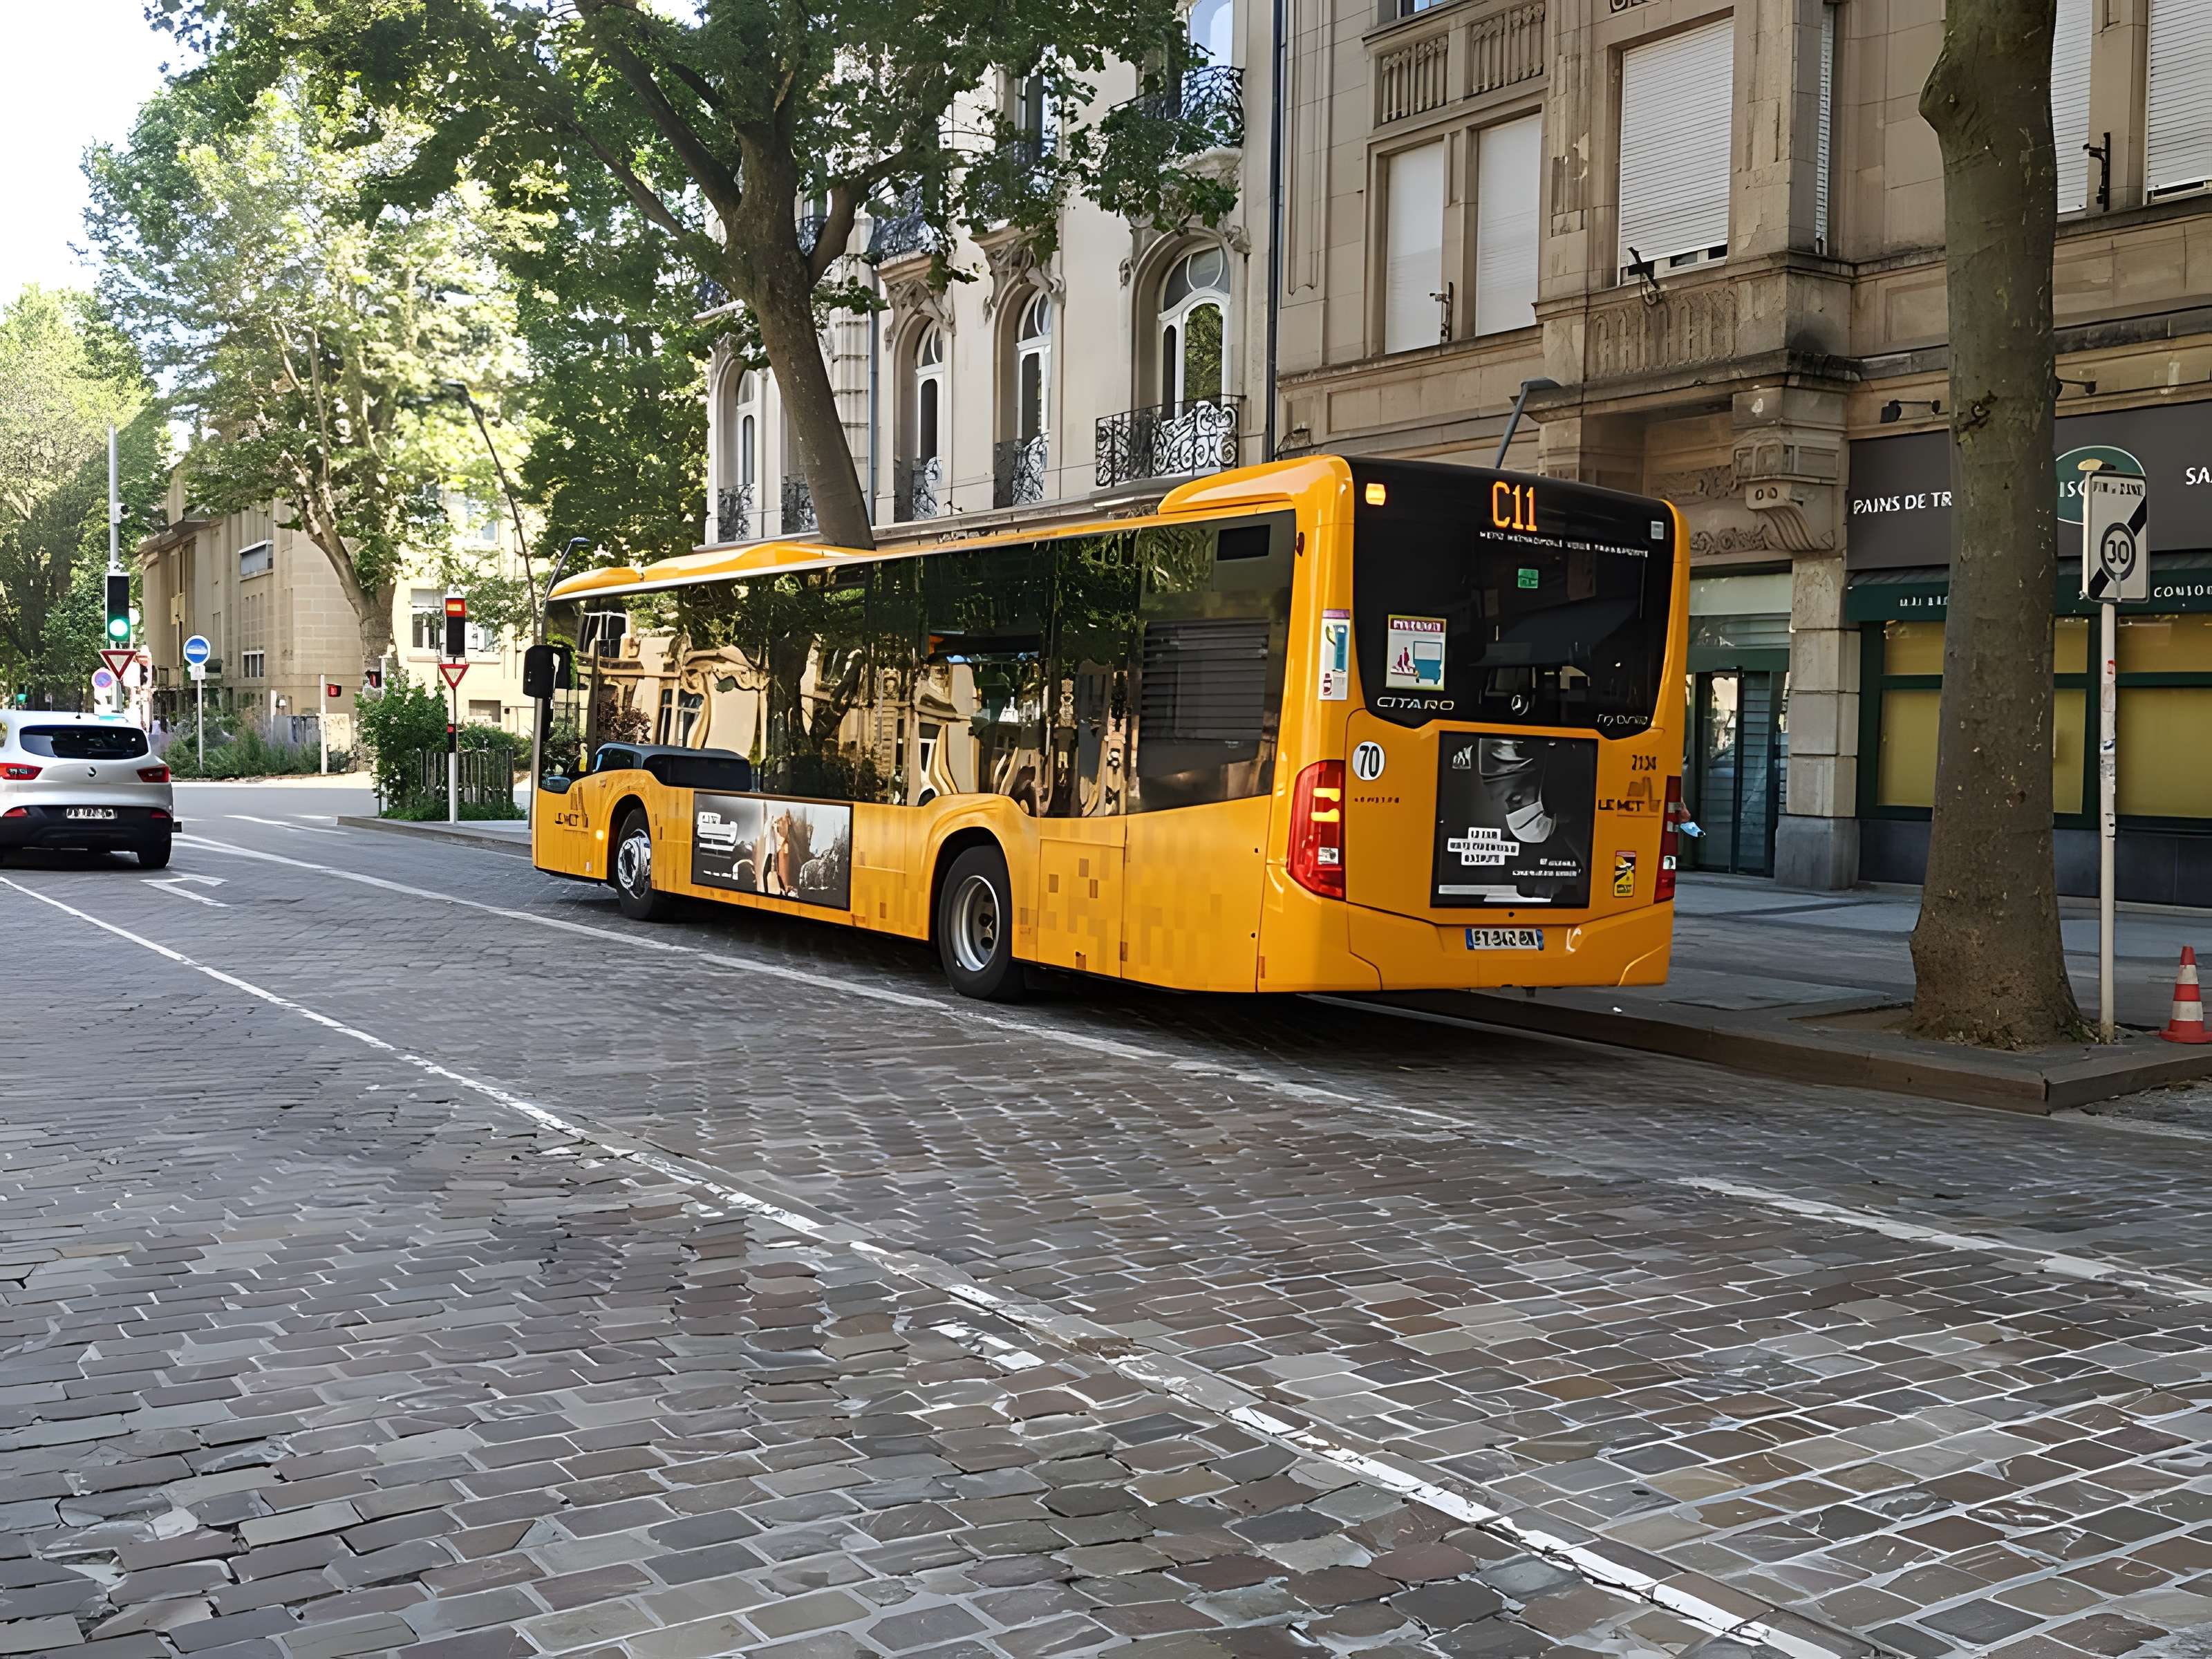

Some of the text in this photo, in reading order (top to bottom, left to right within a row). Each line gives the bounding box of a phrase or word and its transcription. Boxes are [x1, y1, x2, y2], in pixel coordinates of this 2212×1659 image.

[2186, 467, 2212, 485] SA
[1492, 481, 1537, 532] C11
[1853, 496, 1900, 514] PAINS
[1905, 493, 1927, 509] DE
[2106, 539, 2130, 565] 30
[1377, 697, 1454, 711] CITARO
[1360, 745, 1380, 778] 70
